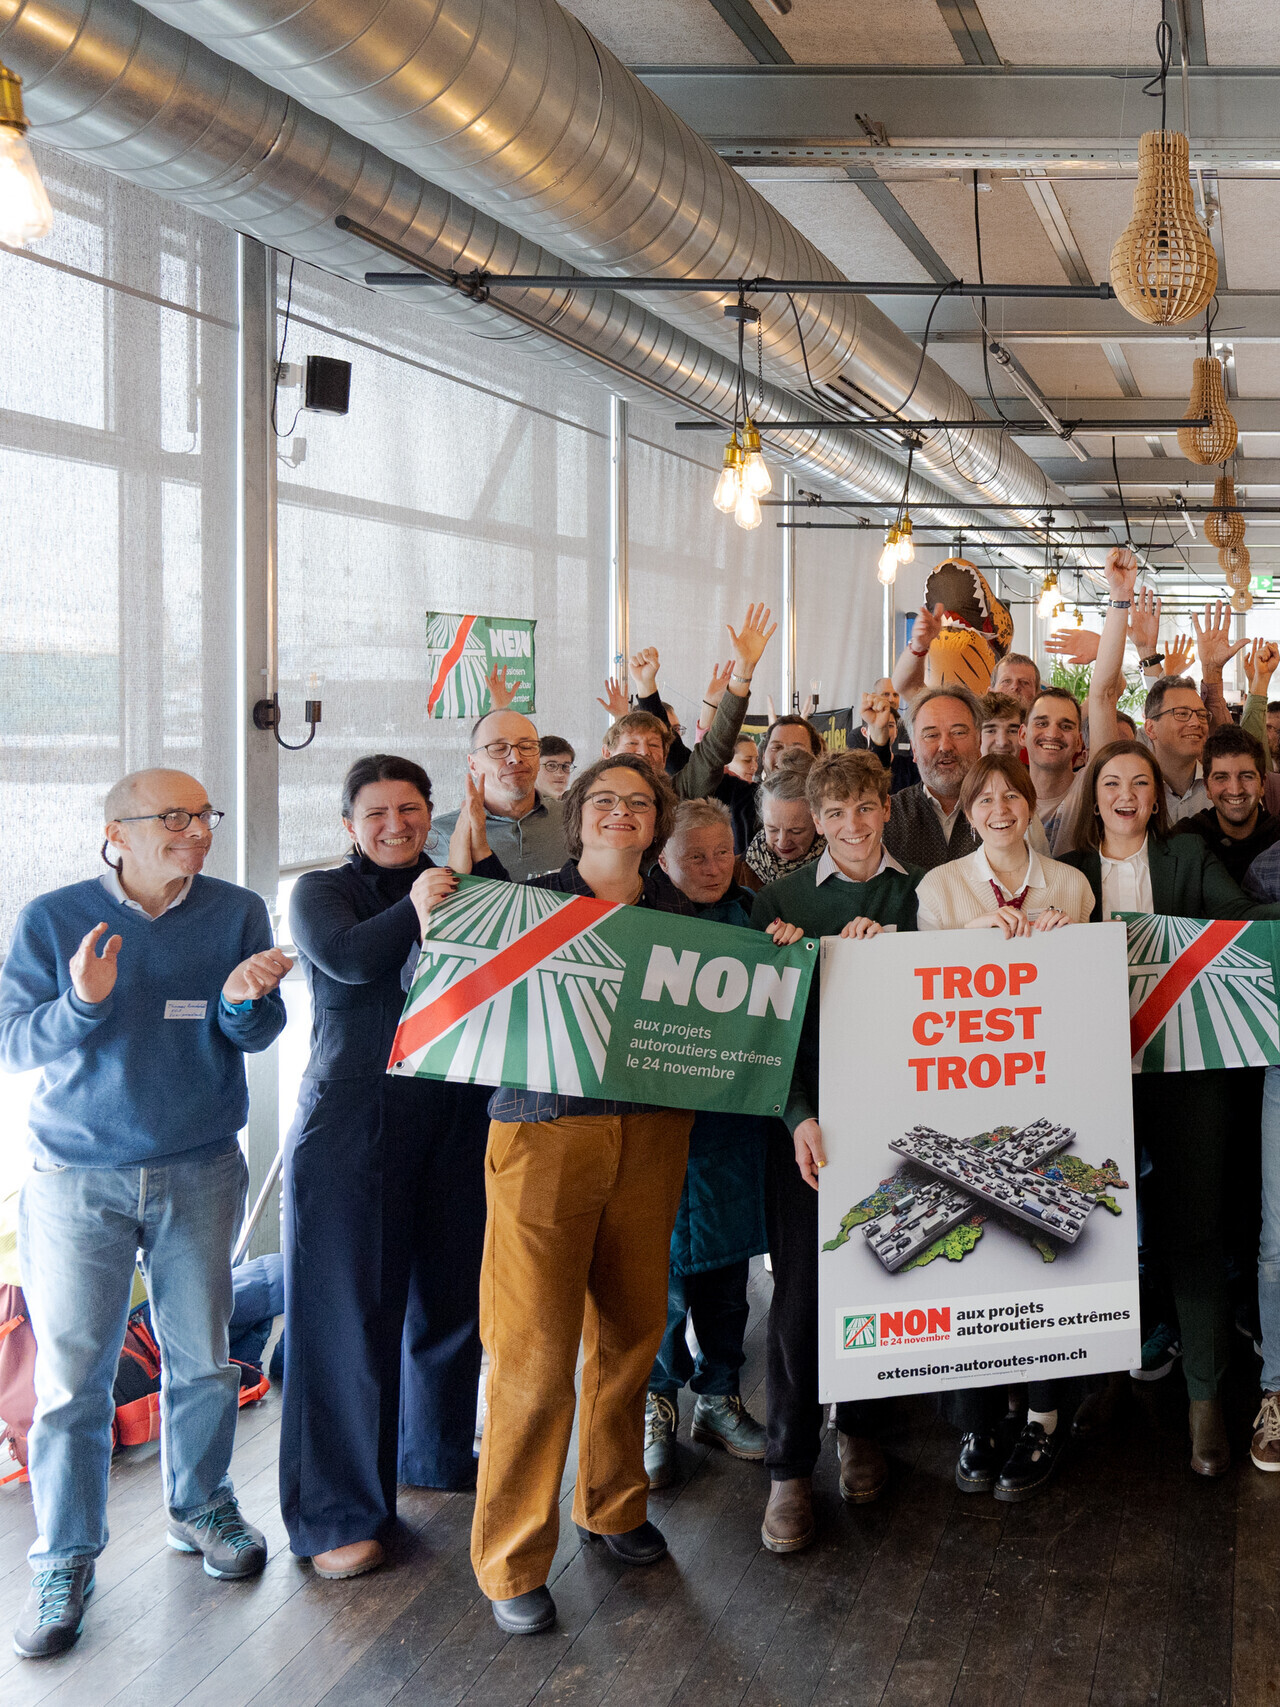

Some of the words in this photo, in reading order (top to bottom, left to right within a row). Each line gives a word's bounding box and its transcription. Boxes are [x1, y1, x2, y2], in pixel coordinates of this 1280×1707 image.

[488, 628, 532, 658] NEIN
[640, 944, 802, 1021] NON
[914, 963, 1037, 1000] TROP
[633, 1019, 661, 1032] aux
[662, 1023, 712, 1040] projets
[913, 1007, 1042, 1046] C'EST
[626, 1053, 639, 1068] le
[641, 1056, 660, 1071] 24
[663, 1062, 735, 1080] novembre
[629, 1038, 717, 1059] autoroutiers
[720, 1050, 782, 1067] extrêmes
[908, 1051, 1045, 1091] TROP!
[880, 1307, 950, 1338] NON
[957, 1310, 984, 1320] aux
[989, 1302, 1043, 1320] projets
[957, 1318, 1054, 1336] autoroutiers
[1059, 1311, 1130, 1325] extrêmes
[880, 1339, 889, 1347] le
[890, 1337, 903, 1346] 24
[904, 1334, 950, 1345] novembre
[877, 1348, 1087, 1380] extension-autoroutes-non.ch
